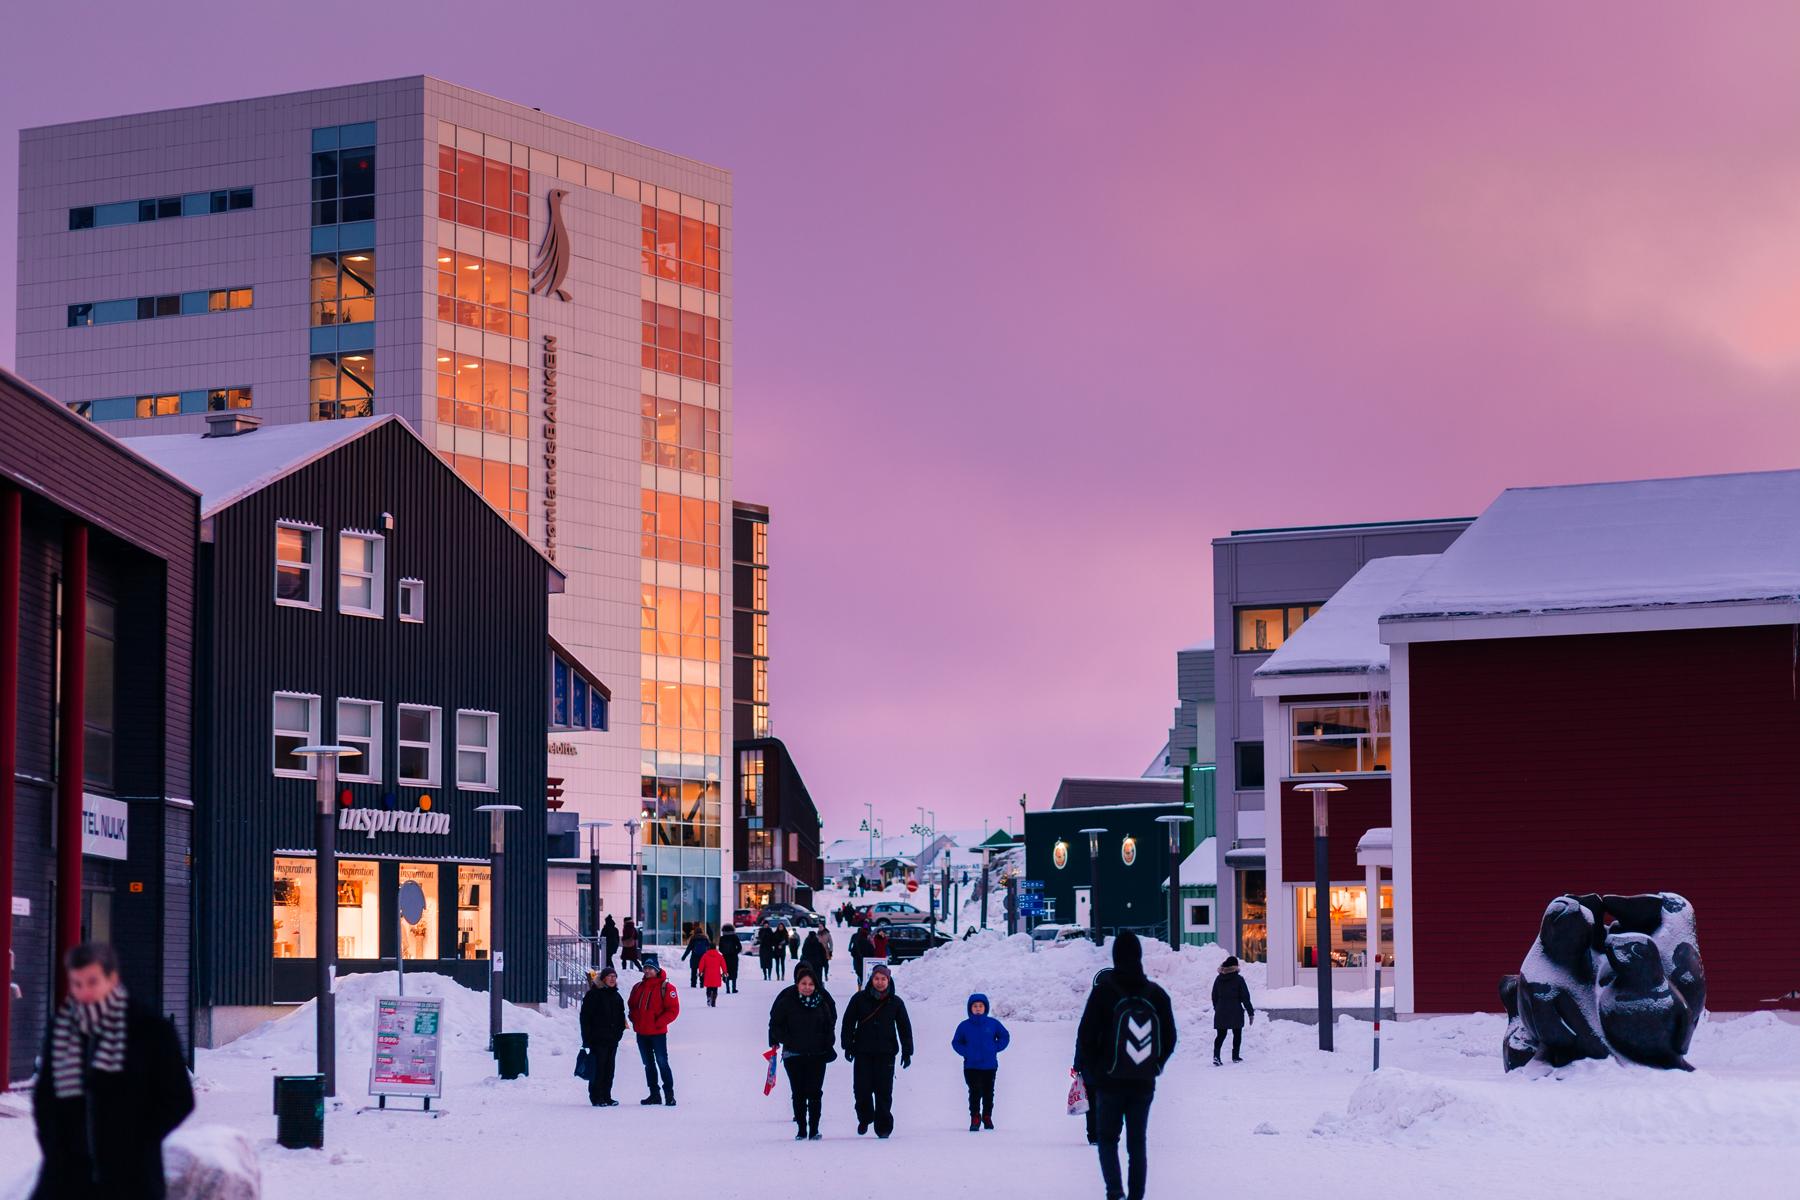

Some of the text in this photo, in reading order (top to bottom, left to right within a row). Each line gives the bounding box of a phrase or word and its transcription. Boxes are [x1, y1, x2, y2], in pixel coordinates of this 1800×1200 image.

[338, 789, 450, 838] inspiration
[82, 811, 126, 841] TEL NUUK
[275, 861, 312, 875] inspiration
[339, 863, 375, 878] inspiration
